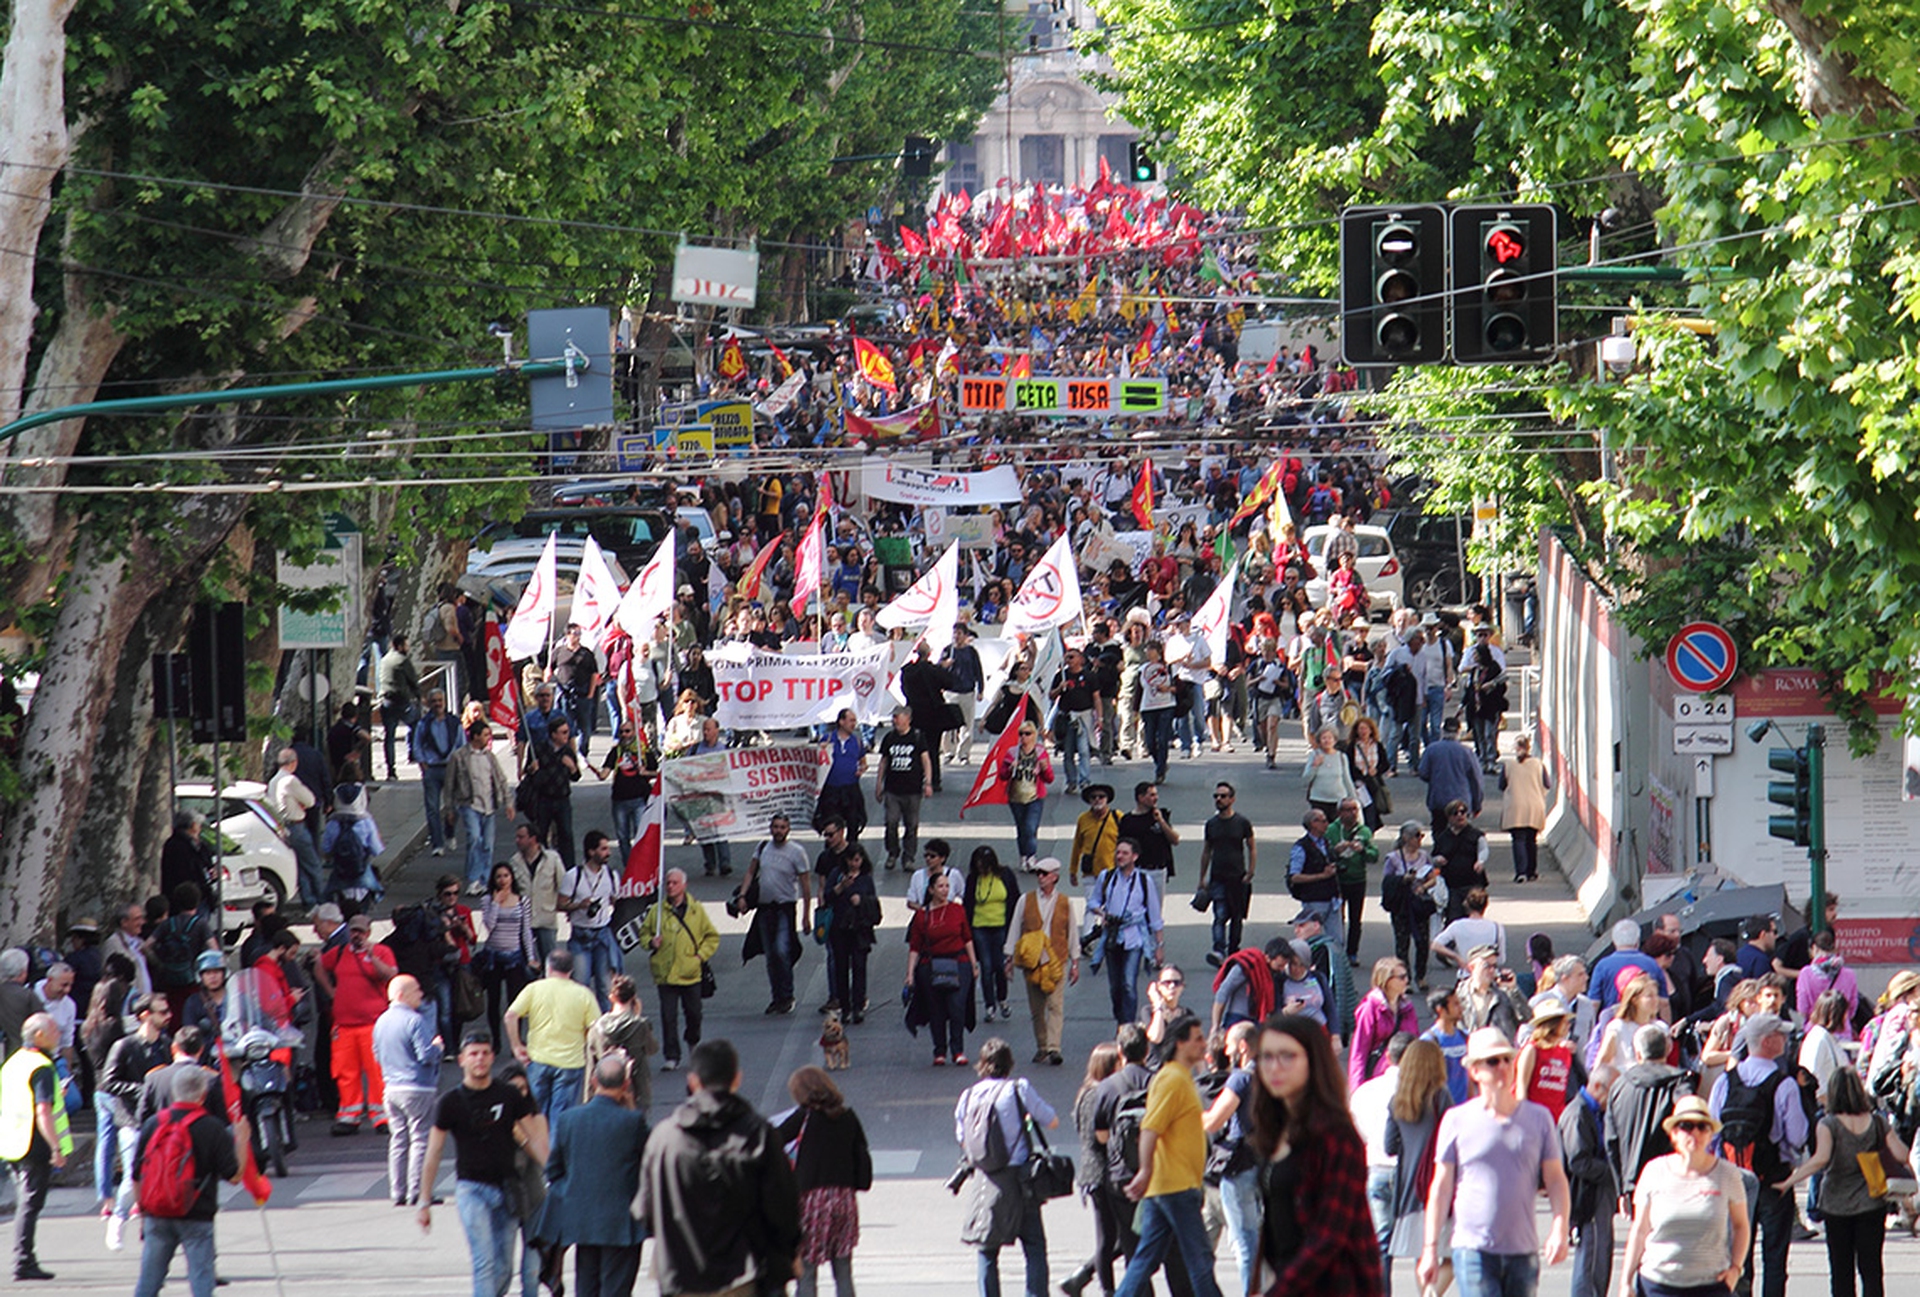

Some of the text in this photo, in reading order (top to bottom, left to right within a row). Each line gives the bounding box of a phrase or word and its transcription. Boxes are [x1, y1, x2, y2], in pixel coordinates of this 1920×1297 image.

[964, 382, 1004, 407] TTIP
[1069, 384, 1108, 409] TISA
[717, 678, 844, 703] TOP TTIP
[1775, 676, 1819, 691] ROMA
[1704, 702, 1728, 716] 24
[729, 746, 831, 770] LOMBARDIA
[746, 766, 819, 788] SISMICA
[1835, 927, 1881, 938] VILUPPO
[1835, 938, 1909, 948] FRASTRUTTURE
